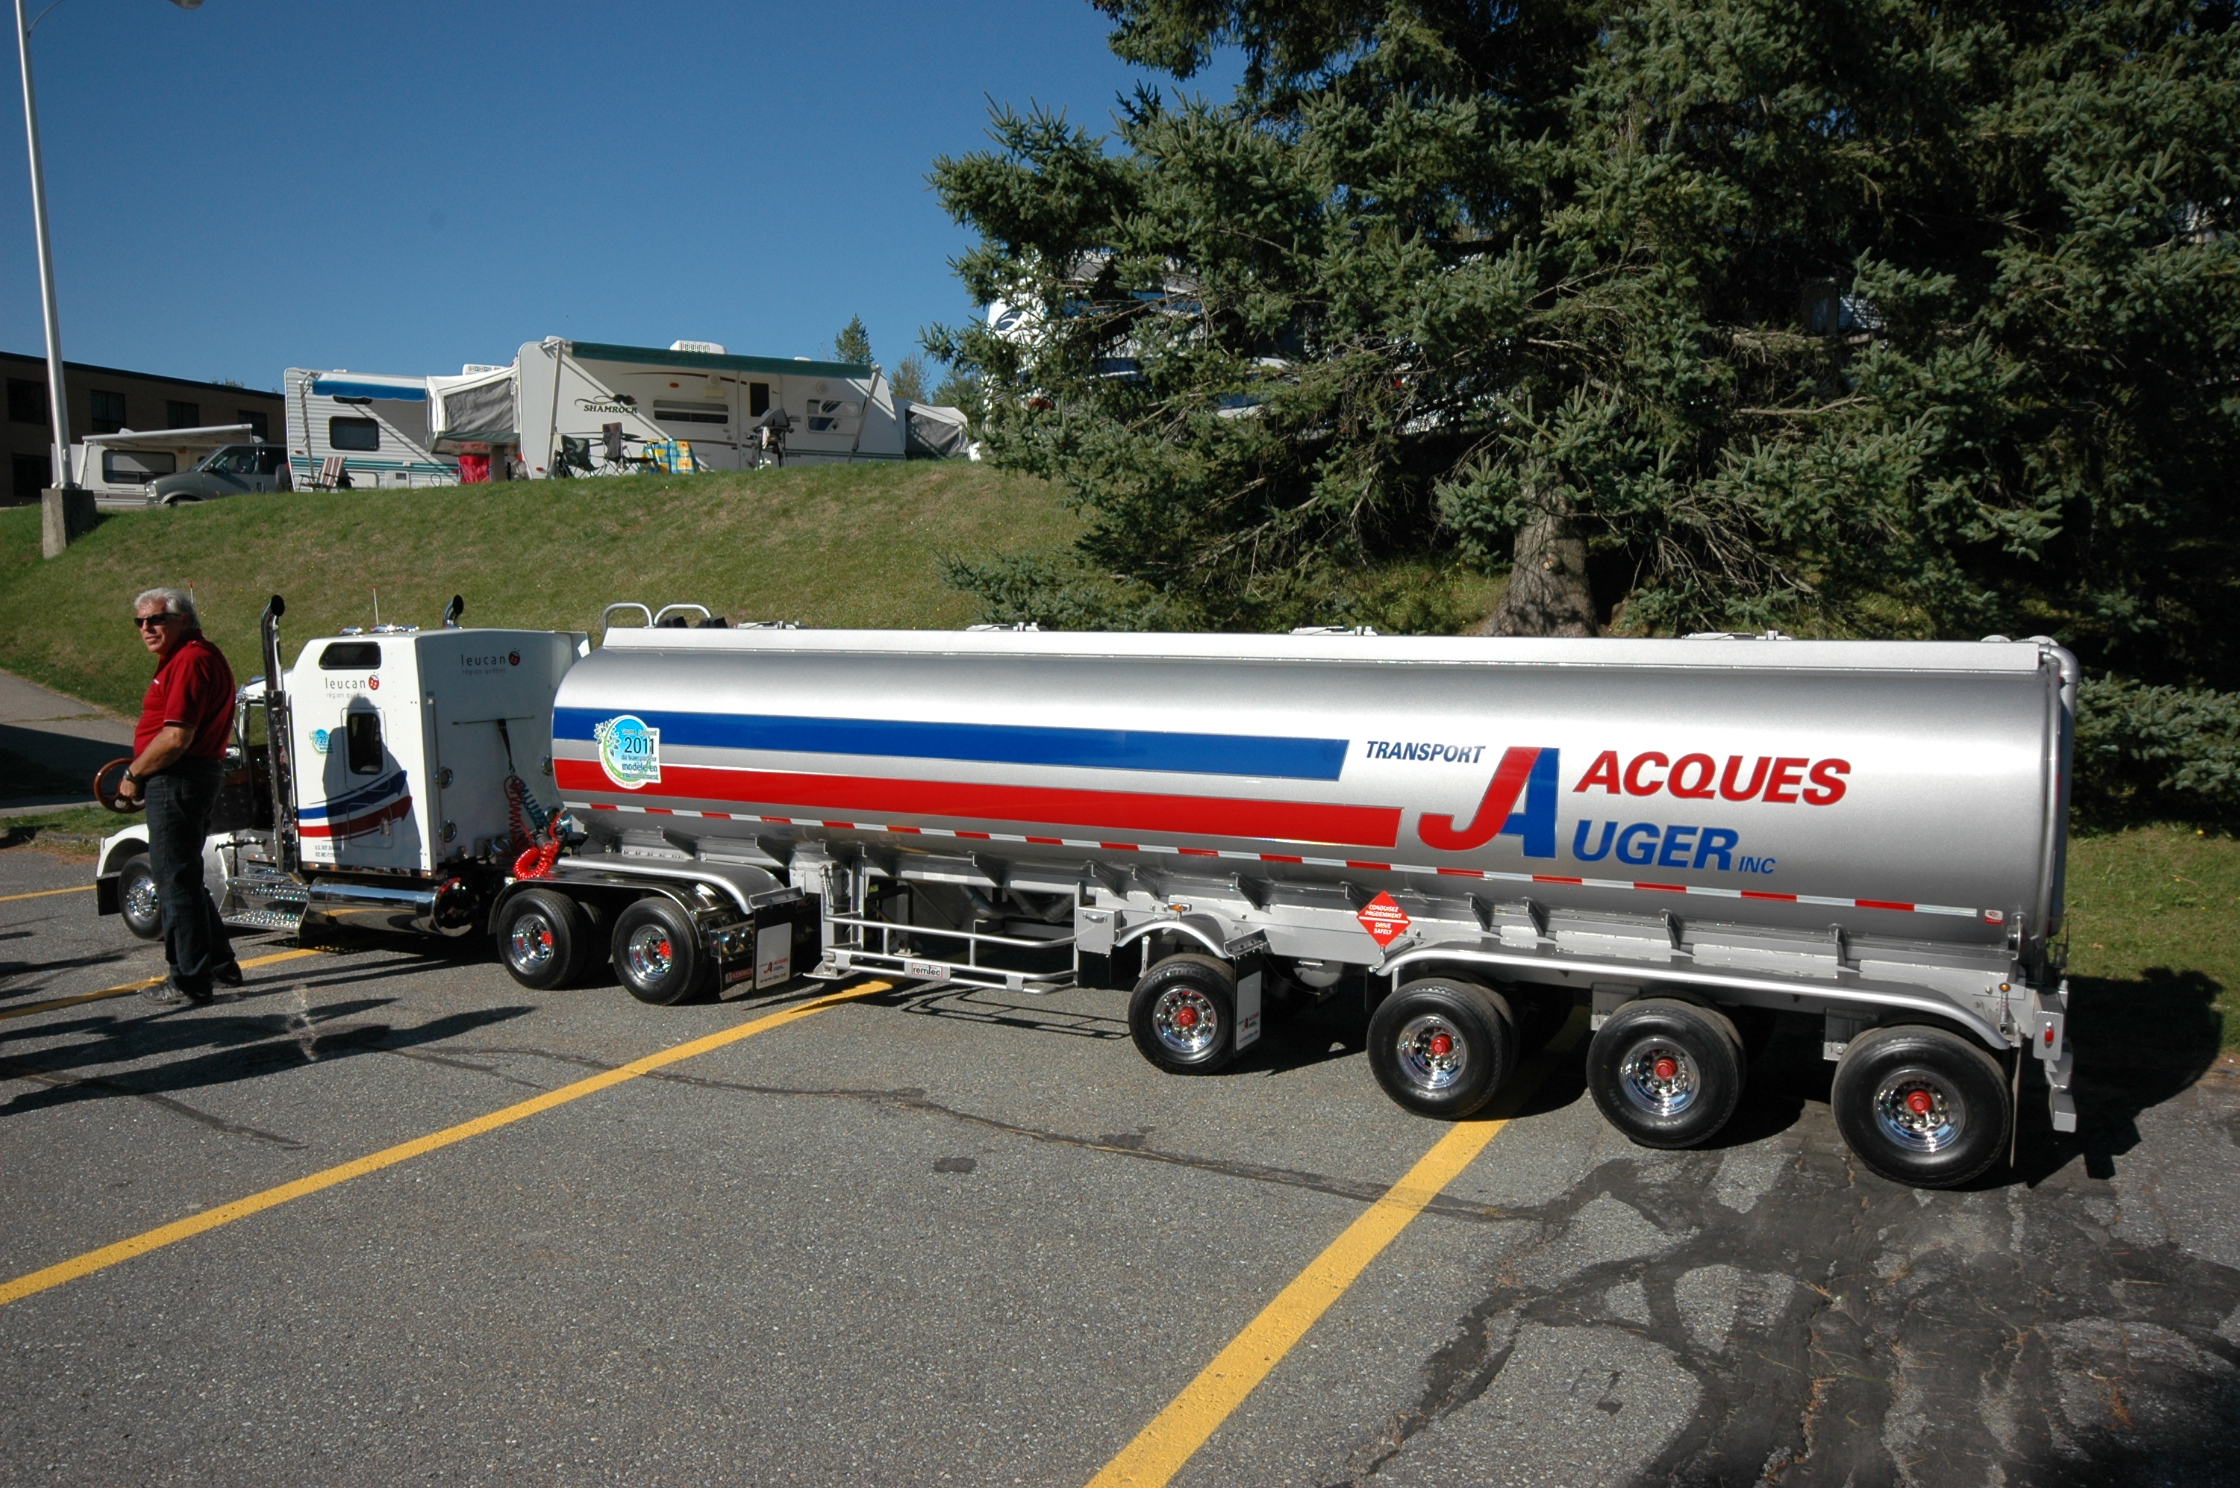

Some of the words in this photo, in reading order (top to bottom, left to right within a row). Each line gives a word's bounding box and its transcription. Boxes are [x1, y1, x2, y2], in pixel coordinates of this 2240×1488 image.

[583, 404, 638, 414] SHAMROCK
[461, 654, 506, 666] leucan
[325, 677, 365, 689] leucan
[624, 736, 655, 755] 2011
[1366, 740, 1485, 763] TRANSPORT
[1573, 750, 1852, 807] ACQUES
[1572, 819, 1740, 871] UGER
[1738, 856, 1777, 876] INC
